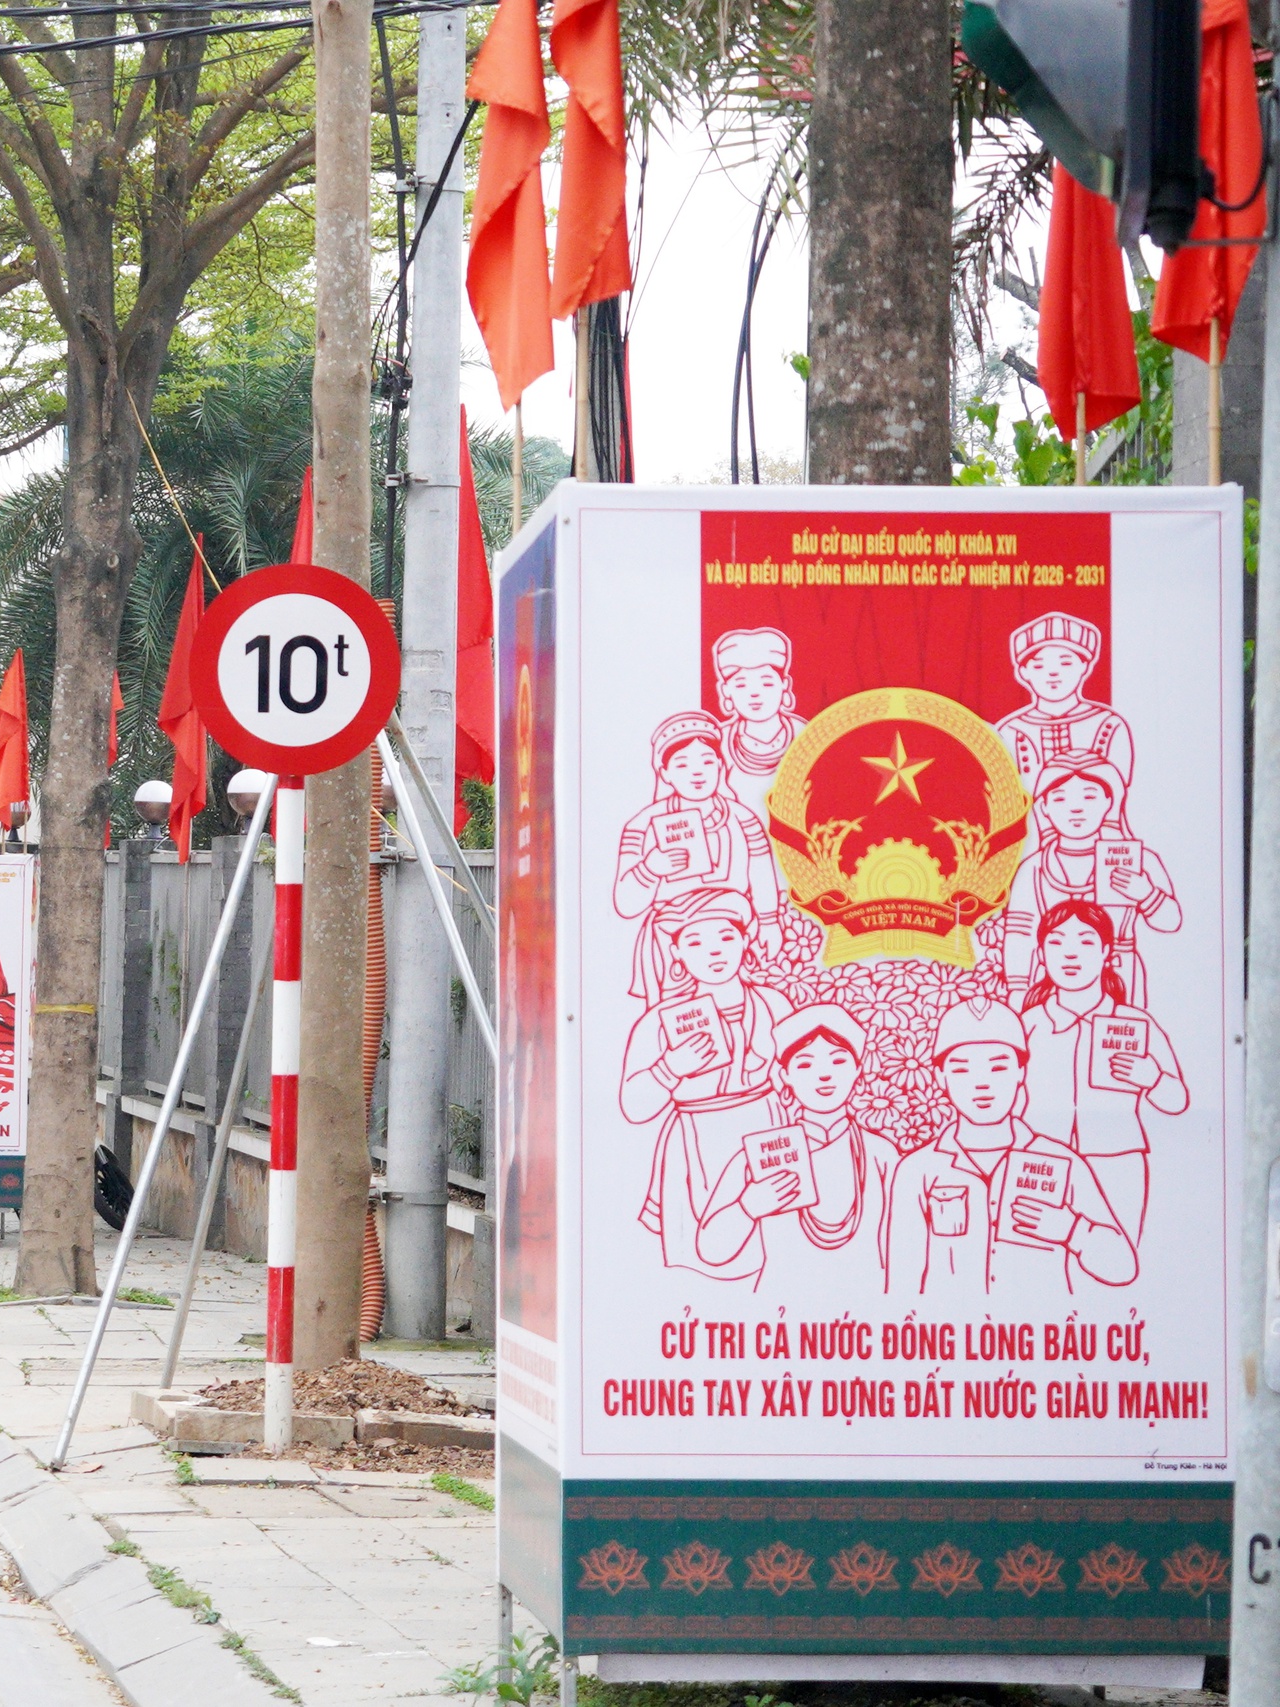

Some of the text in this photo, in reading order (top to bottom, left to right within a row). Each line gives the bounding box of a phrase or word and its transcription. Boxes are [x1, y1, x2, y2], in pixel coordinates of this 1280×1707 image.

[792, 526, 1016, 558] BẦU CỬ ĐẠI BIỂU QUỐC HỘI KHÓA XVI
[706, 559, 723, 584] VÀ
[725, 564, 747, 588] ĐẠI
[749, 557, 779, 585] BIỂU
[782, 560, 803, 588] HỘI
[806, 558, 841, 585] ĐỒNG
[844, 560, 879, 585] NHÂN
[882, 560, 909, 585] DÂN
[912, 561, 937, 585] CÁC
[941, 557, 966, 585] CẤP
[969, 561, 1010, 589] NHIỆM
[1014, 561, 1030, 585] KỲ
[1033, 565, 1064, 585] 2026
[1076, 565, 1104, 585] 2031
[861, 909, 937, 928] VIỆT NAM
[1107, 1023, 1136, 1036] PHIẾU
[1102, 1036, 1140, 1051] BẦU CỬ
[759, 1134, 791, 1153] PHIẾU
[759, 1148, 799, 1170] BẦU CỬ
[1023, 1161, 1054, 1177] PHIẾU
[1017, 1173, 1057, 1193] BẦU CỬ
[662, 1306, 1149, 1366] CỬ TRI CẢ NƯỚC ĐỒNG LÒNG BẦU CỬ,
[604, 1379, 693, 1416] CHUNG
[704, 1380, 751, 1416] TAY
[761, 1372, 812, 1416] XÂY
[823, 1377, 894, 1425] DỰNG
[904, 1367, 954, 1417] ĐẤT
[964, 1370, 1036, 1418] NƯỚC
[1047, 1373, 1108, 1419] GIÀU
[1119, 1382, 1208, 1427] MẠNH!
